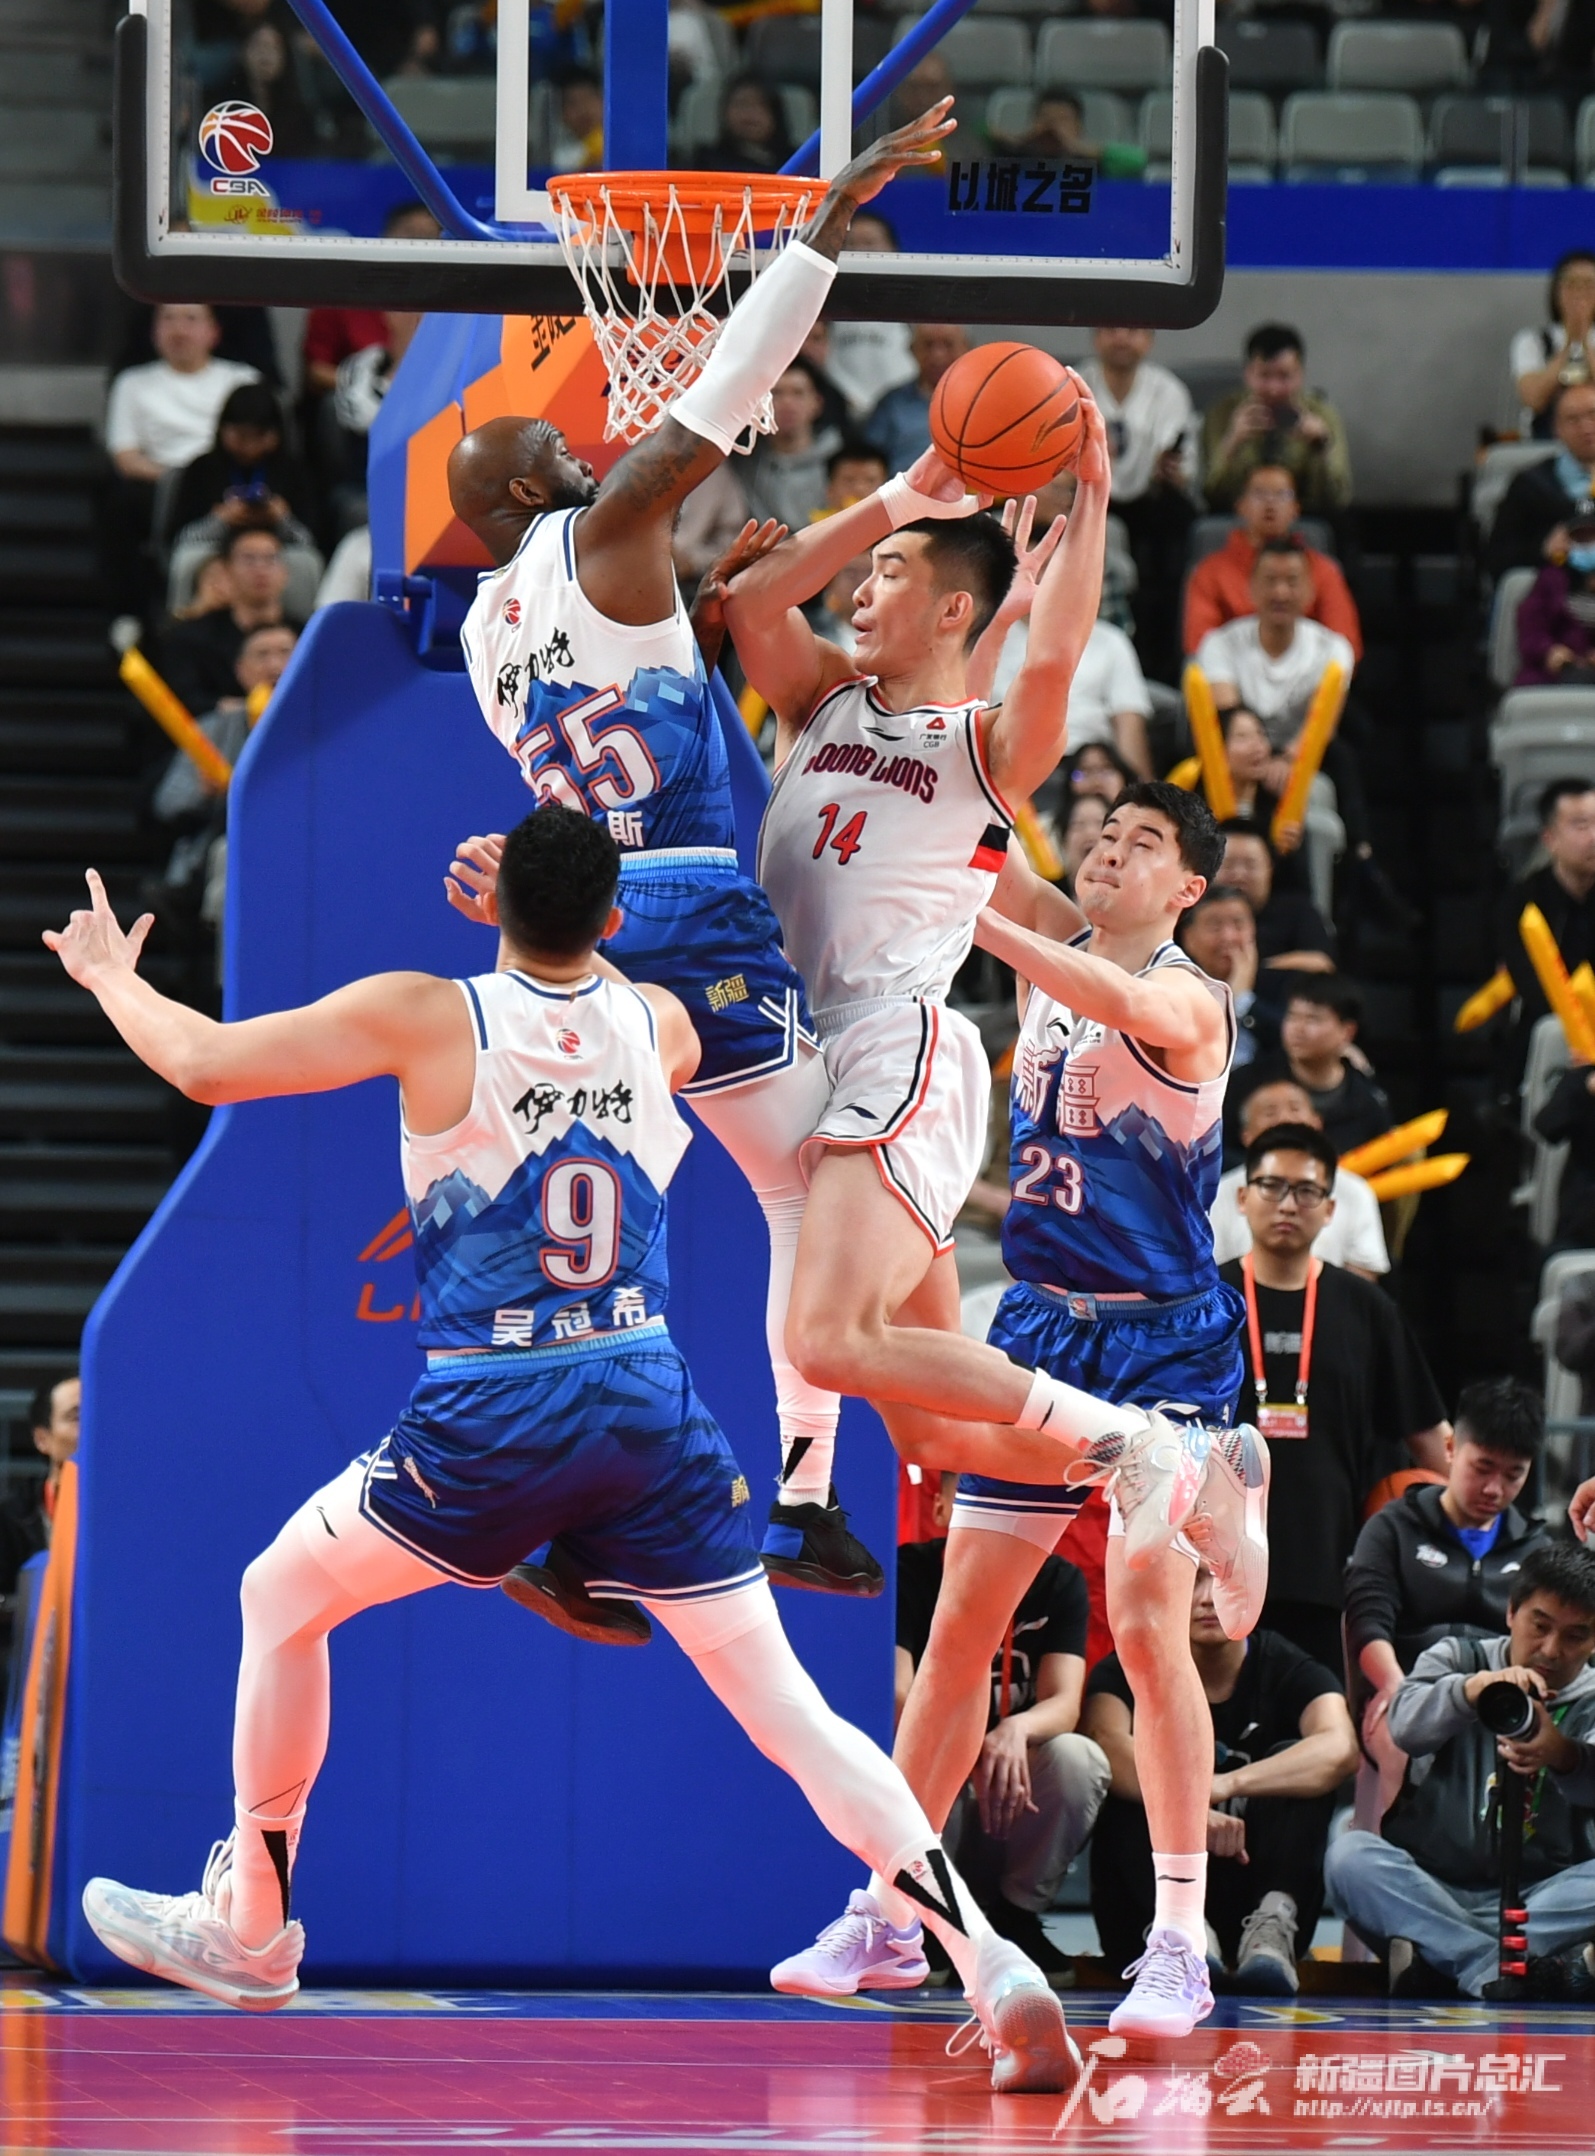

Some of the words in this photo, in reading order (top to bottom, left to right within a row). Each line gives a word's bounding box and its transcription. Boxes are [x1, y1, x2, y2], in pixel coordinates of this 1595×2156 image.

[211, 178, 270, 196] CBA
[949, 162, 1093, 213] 以城之名
[512, 683, 661, 817] 55
[869, 755, 939, 804] LIONS
[606, 811, 645, 848] 斯
[812, 802, 867, 866] 14
[1012, 1143, 1084, 1215] 23
[539, 1157, 622, 1290] 9
[491, 1286, 647, 1347] 吴冠希
